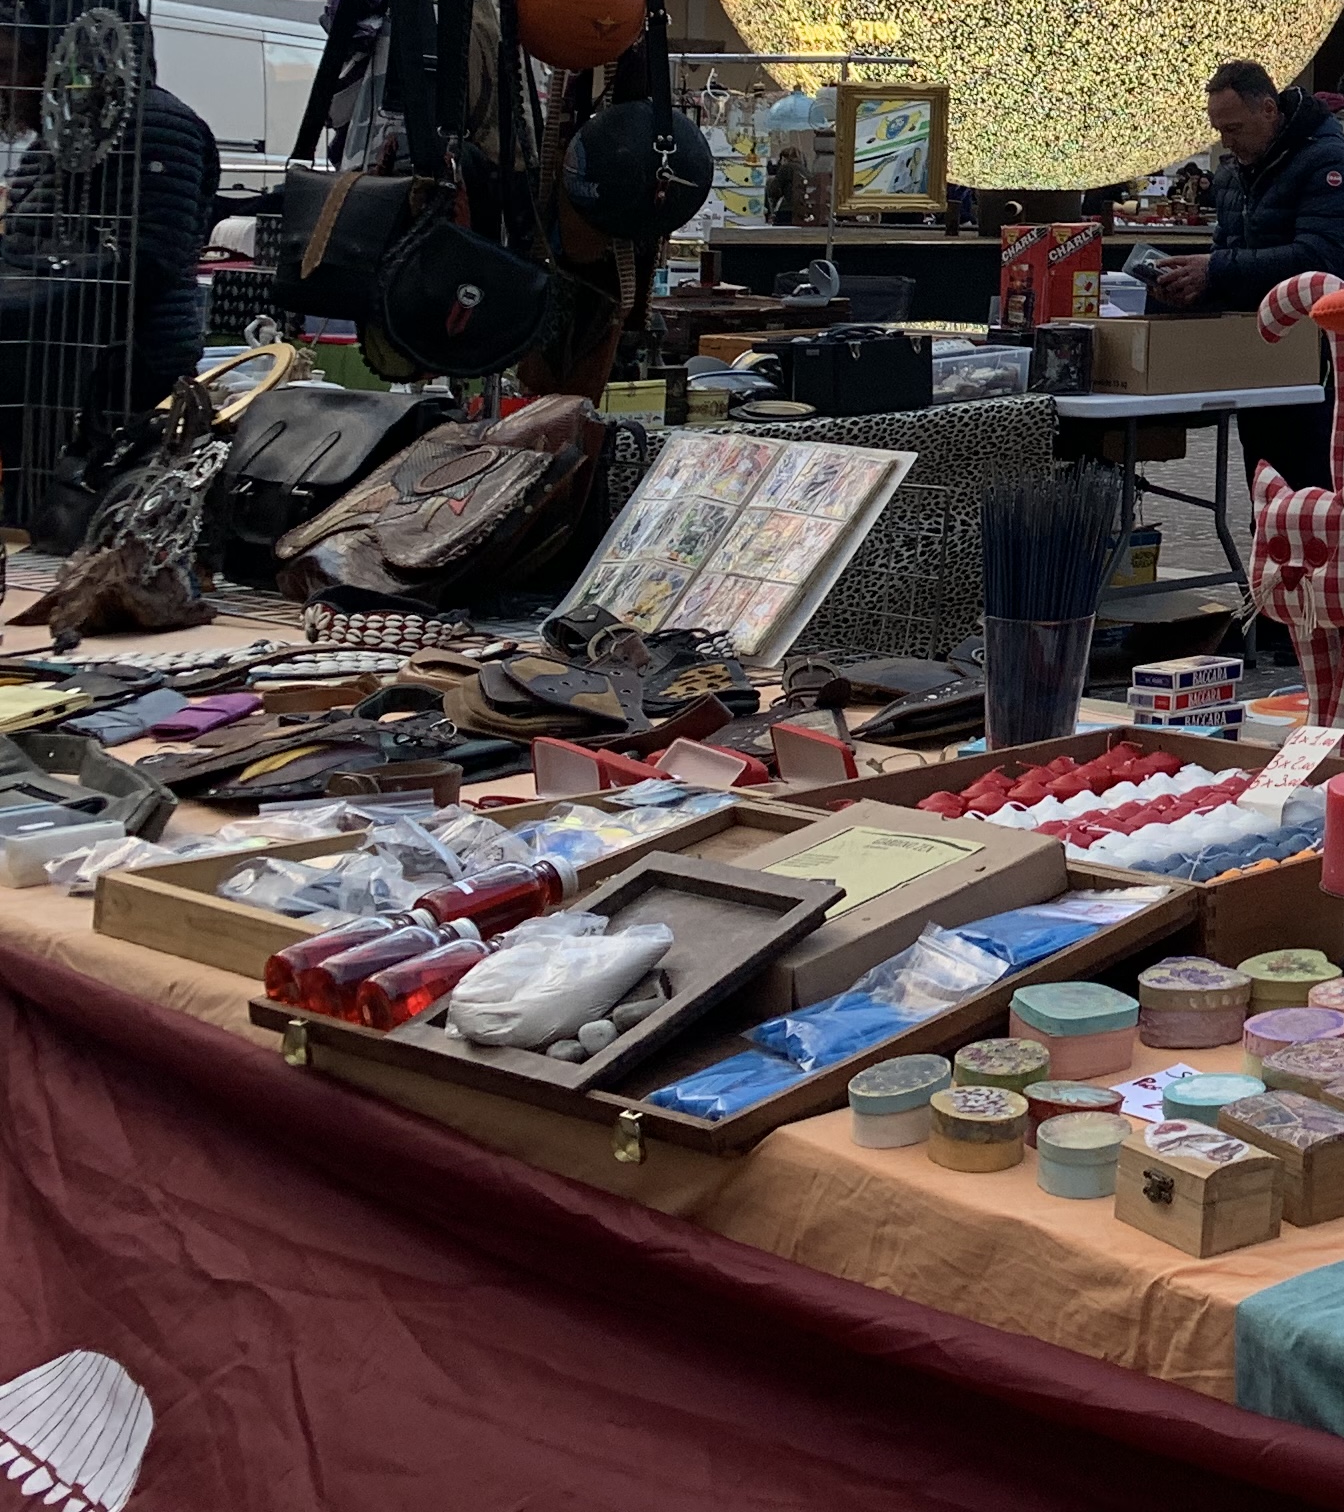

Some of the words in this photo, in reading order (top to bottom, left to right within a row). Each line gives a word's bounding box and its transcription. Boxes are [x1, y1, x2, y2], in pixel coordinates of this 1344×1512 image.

[1001, 228, 1040, 262] CHARLY
[1048, 227, 1095, 261] CHARLY
[1192, 668, 1228, 685] BACCARA
